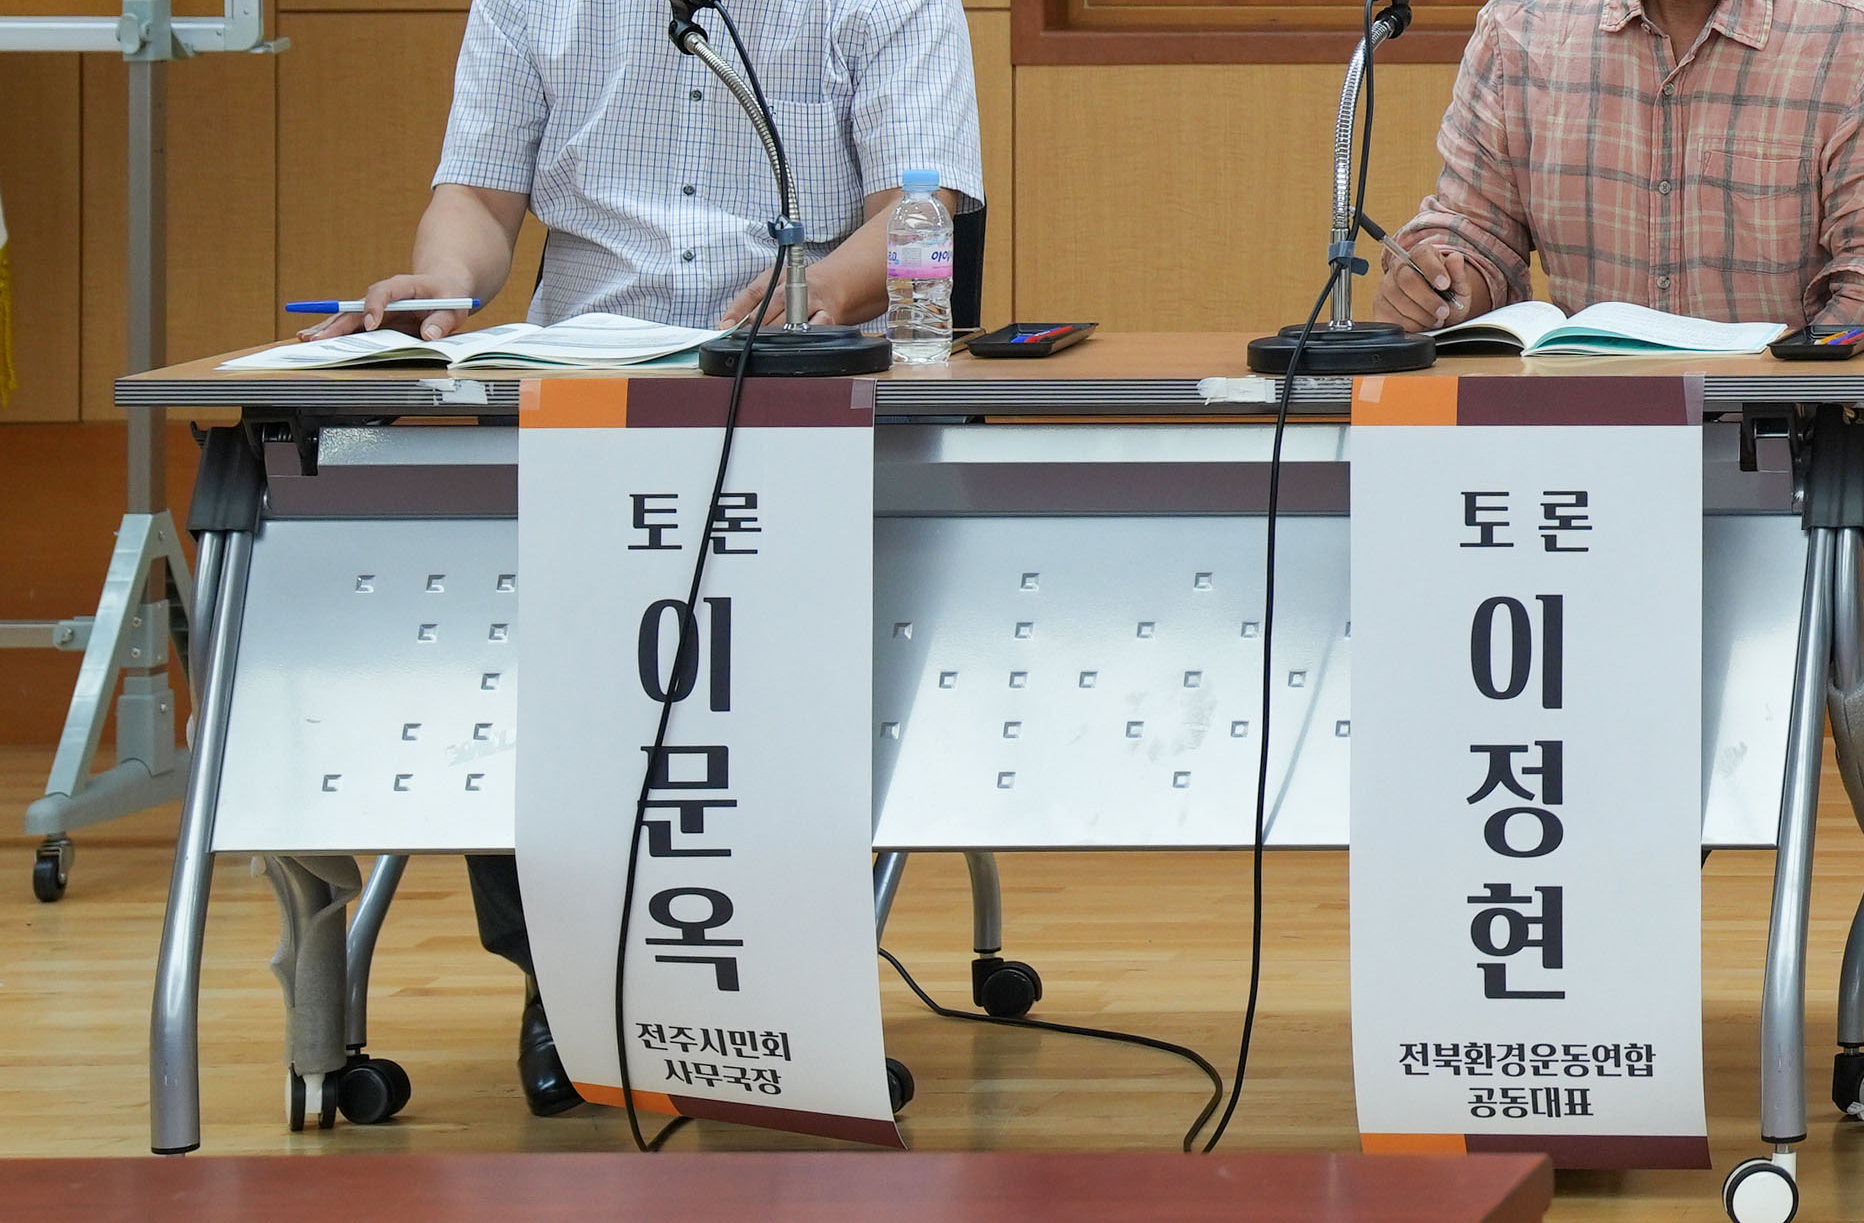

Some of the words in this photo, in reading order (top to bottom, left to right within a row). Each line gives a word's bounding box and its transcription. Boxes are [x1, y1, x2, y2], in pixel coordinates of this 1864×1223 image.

[636, 595, 744, 992] 이문옥
[1466, 594, 1566, 1000] 이정현
[635, 1022, 792, 1061] 전주시민회
[1399, 1041, 1656, 1078] 전북환경운동연합
[664, 1059, 782, 1095] 사무국장
[1467, 1086, 1594, 1119] 공동대표
